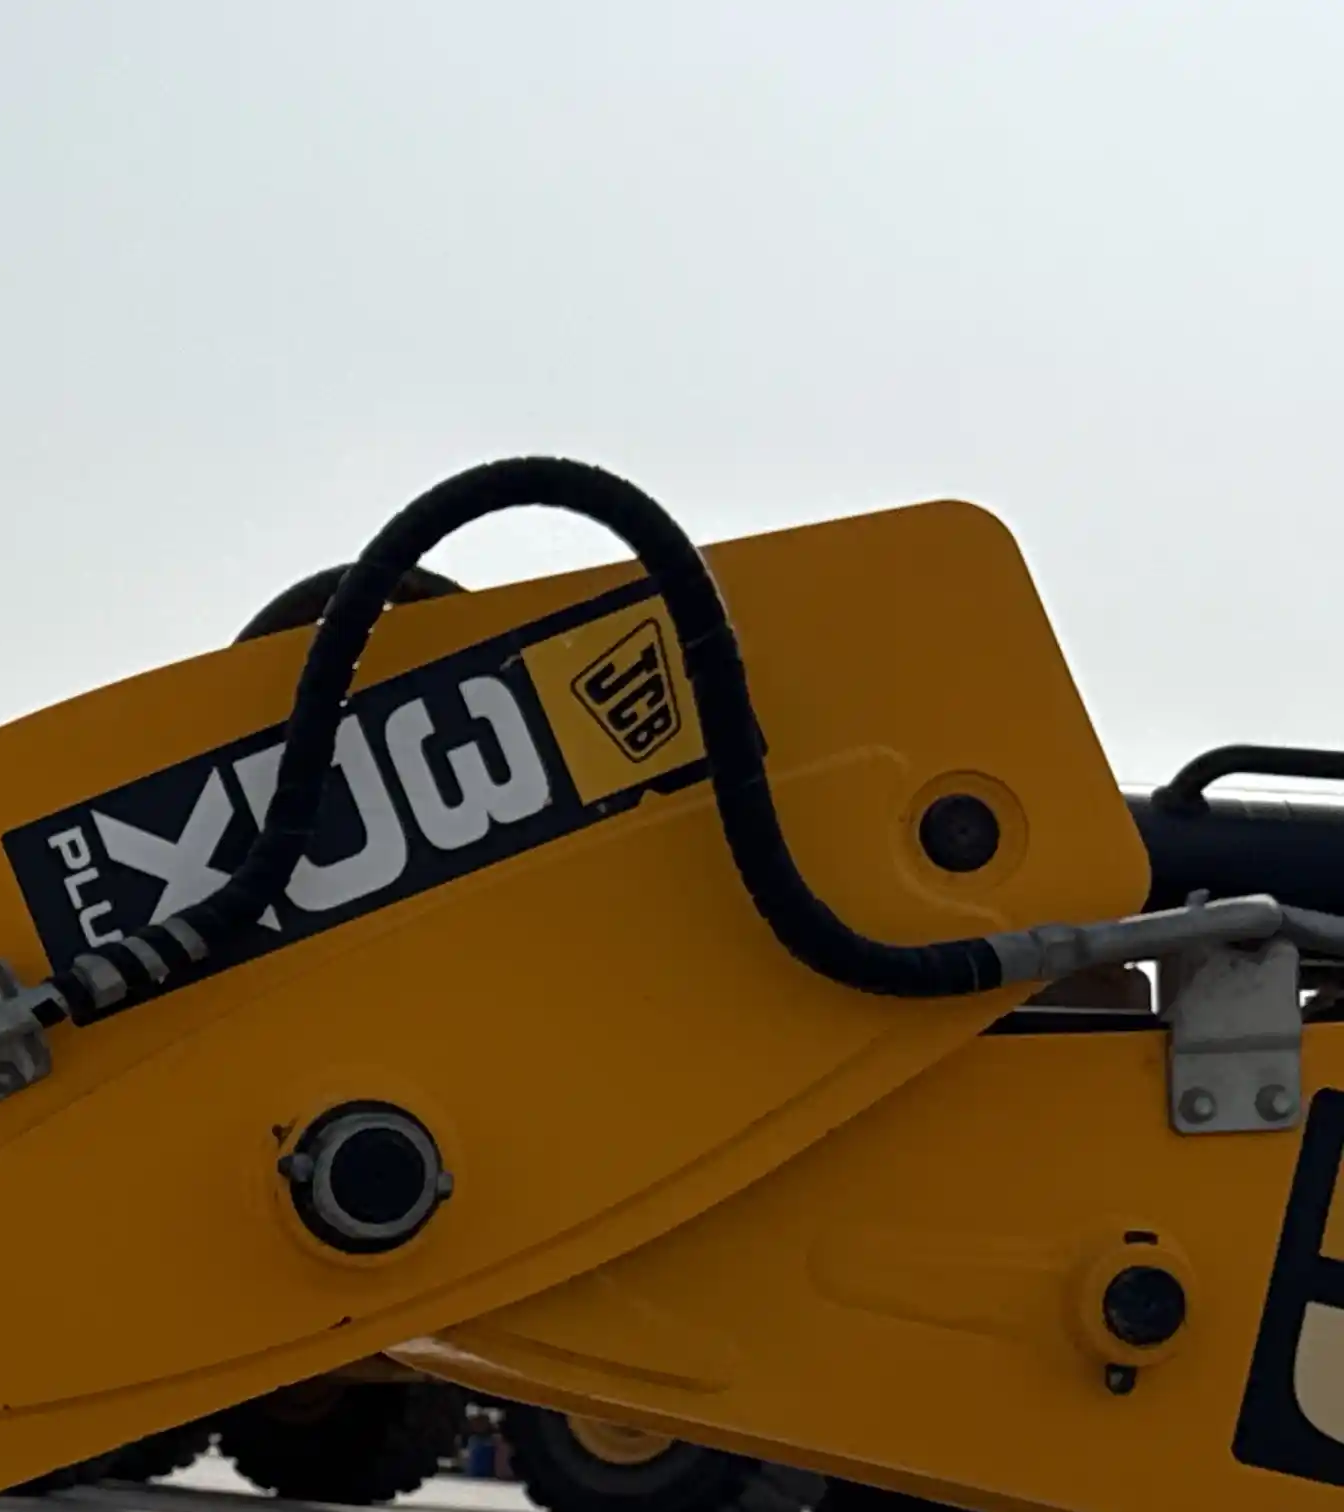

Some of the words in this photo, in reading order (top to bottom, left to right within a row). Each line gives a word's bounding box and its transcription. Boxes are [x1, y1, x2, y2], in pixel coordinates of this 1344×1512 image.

[582, 640, 678, 757] JCB
[90, 676, 551, 931] 3DX
[48, 826, 125, 948] PLU
